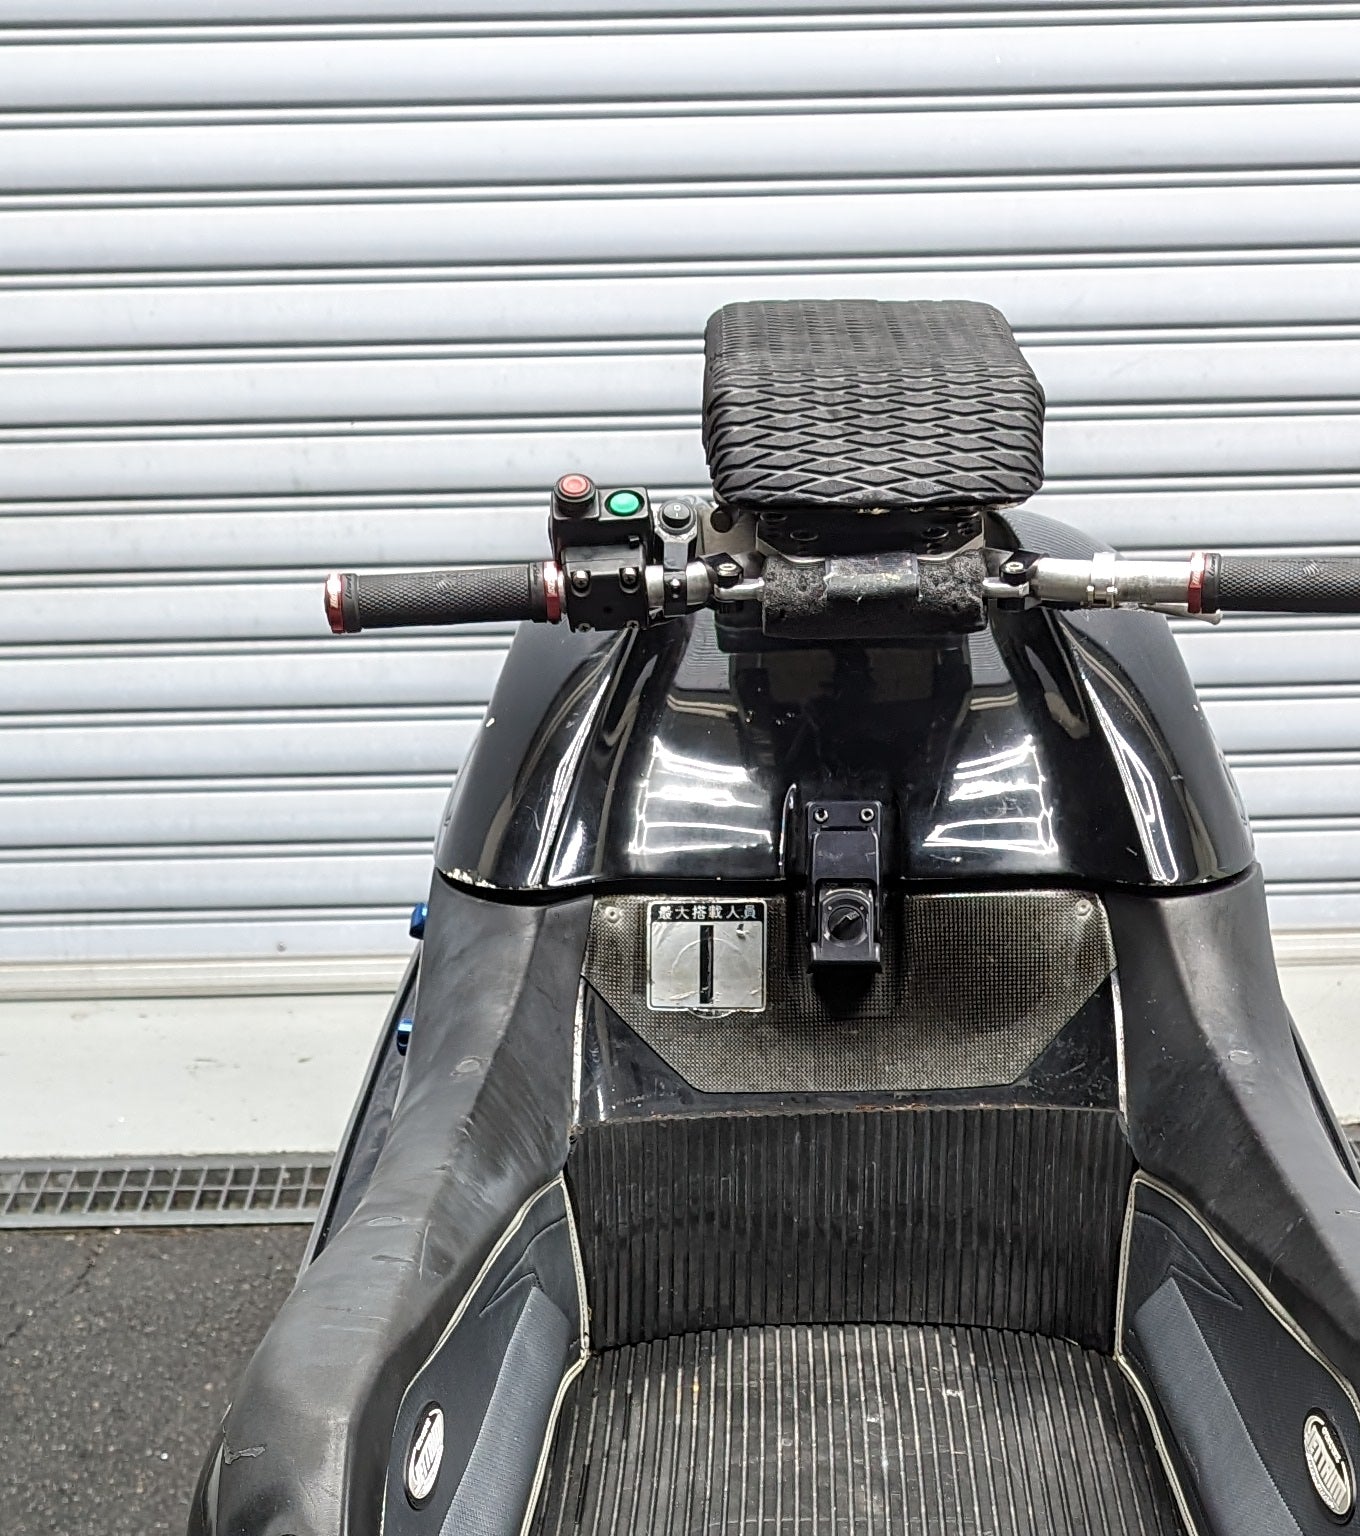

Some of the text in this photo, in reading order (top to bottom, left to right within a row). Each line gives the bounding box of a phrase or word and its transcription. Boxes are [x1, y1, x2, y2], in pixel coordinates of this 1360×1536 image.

[658, 904, 757, 920] 最大搭載人員
[700, 925, 714, 1004] 1
